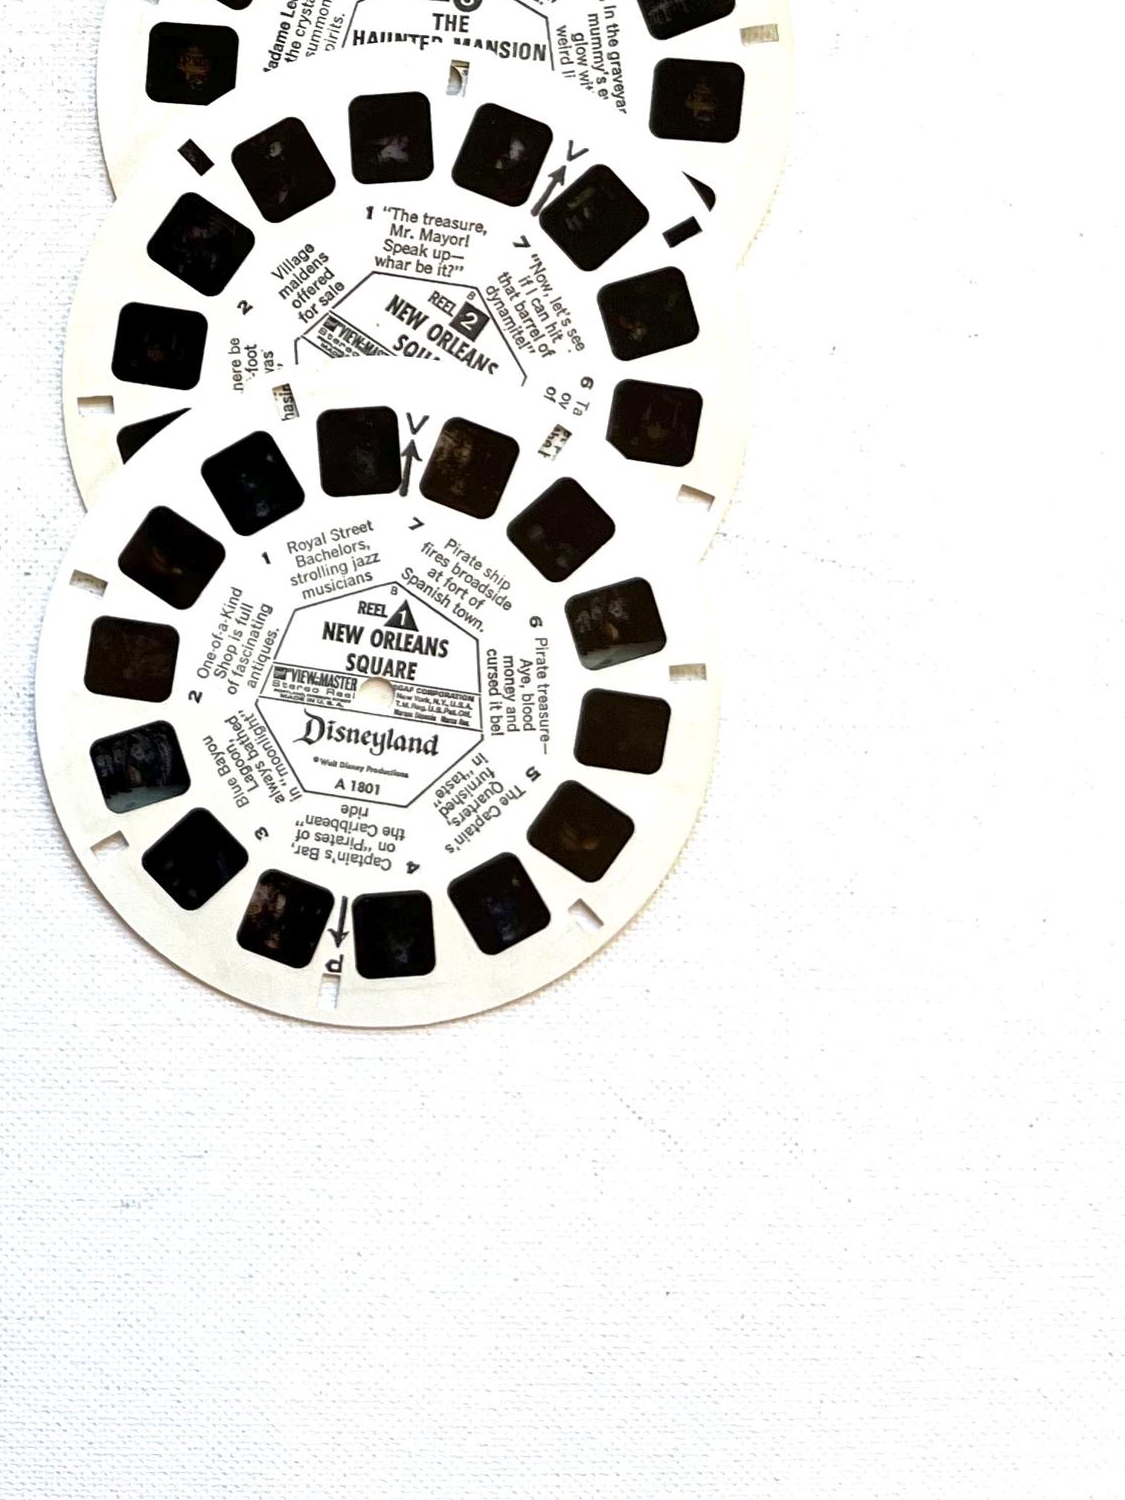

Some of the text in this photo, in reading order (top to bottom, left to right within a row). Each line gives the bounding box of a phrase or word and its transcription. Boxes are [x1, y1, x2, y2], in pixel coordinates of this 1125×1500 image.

[433, 13, 470, 33] THE
[389, 223, 414, 240] Mr.
[423, 213, 488, 235] treasure,
[271, 243, 315, 281] Village
[375, 255, 411, 273] whar
[415, 260, 433, 274] be
[383, 239, 428, 258] Speak
[278, 251, 329, 300] maidens
[291, 266, 335, 309] offered
[298, 281, 345, 324] for sale
[385, 294, 429, 330] NEW
[427, 290, 458, 317] REEL
[287, 519, 374, 554] Royal Street
[295, 540, 371, 568] Bachelors,
[290, 553, 381, 587] strolling jazz
[420, 541, 512, 611] fires broadside
[443, 538, 511, 592] Pirate ship
[302, 571, 373, 600] musicians
[401, 567, 486, 633] Spanish town.
[426, 567, 487, 611] at fort of
[358, 601, 388, 618] REEL
[197, 586, 244, 679] One-of-a-Kind
[214, 602, 254, 679] Shop is full
[227, 603, 274, 695] of fascinating
[322, 621, 449, 658] NEW ORLEANS
[247, 628, 280, 688] antiques.
[345, 653, 418, 681] SQUARE
[486, 648, 502, 696] cursed
[534, 637, 549, 679] Pirate
[489, 701, 503, 711] it
[502, 655, 520, 732] money and
[517, 658, 537, 731] Aye, blood
[293, 708, 439, 756] Disneyland
[334, 778, 381, 796] A 1801
[340, 803, 369, 819] ride
[295, 829, 311, 842] of
[378, 841, 396, 852] on
[382, 826, 406, 841] the
[291, 842, 392, 871] Captain's Bar,
